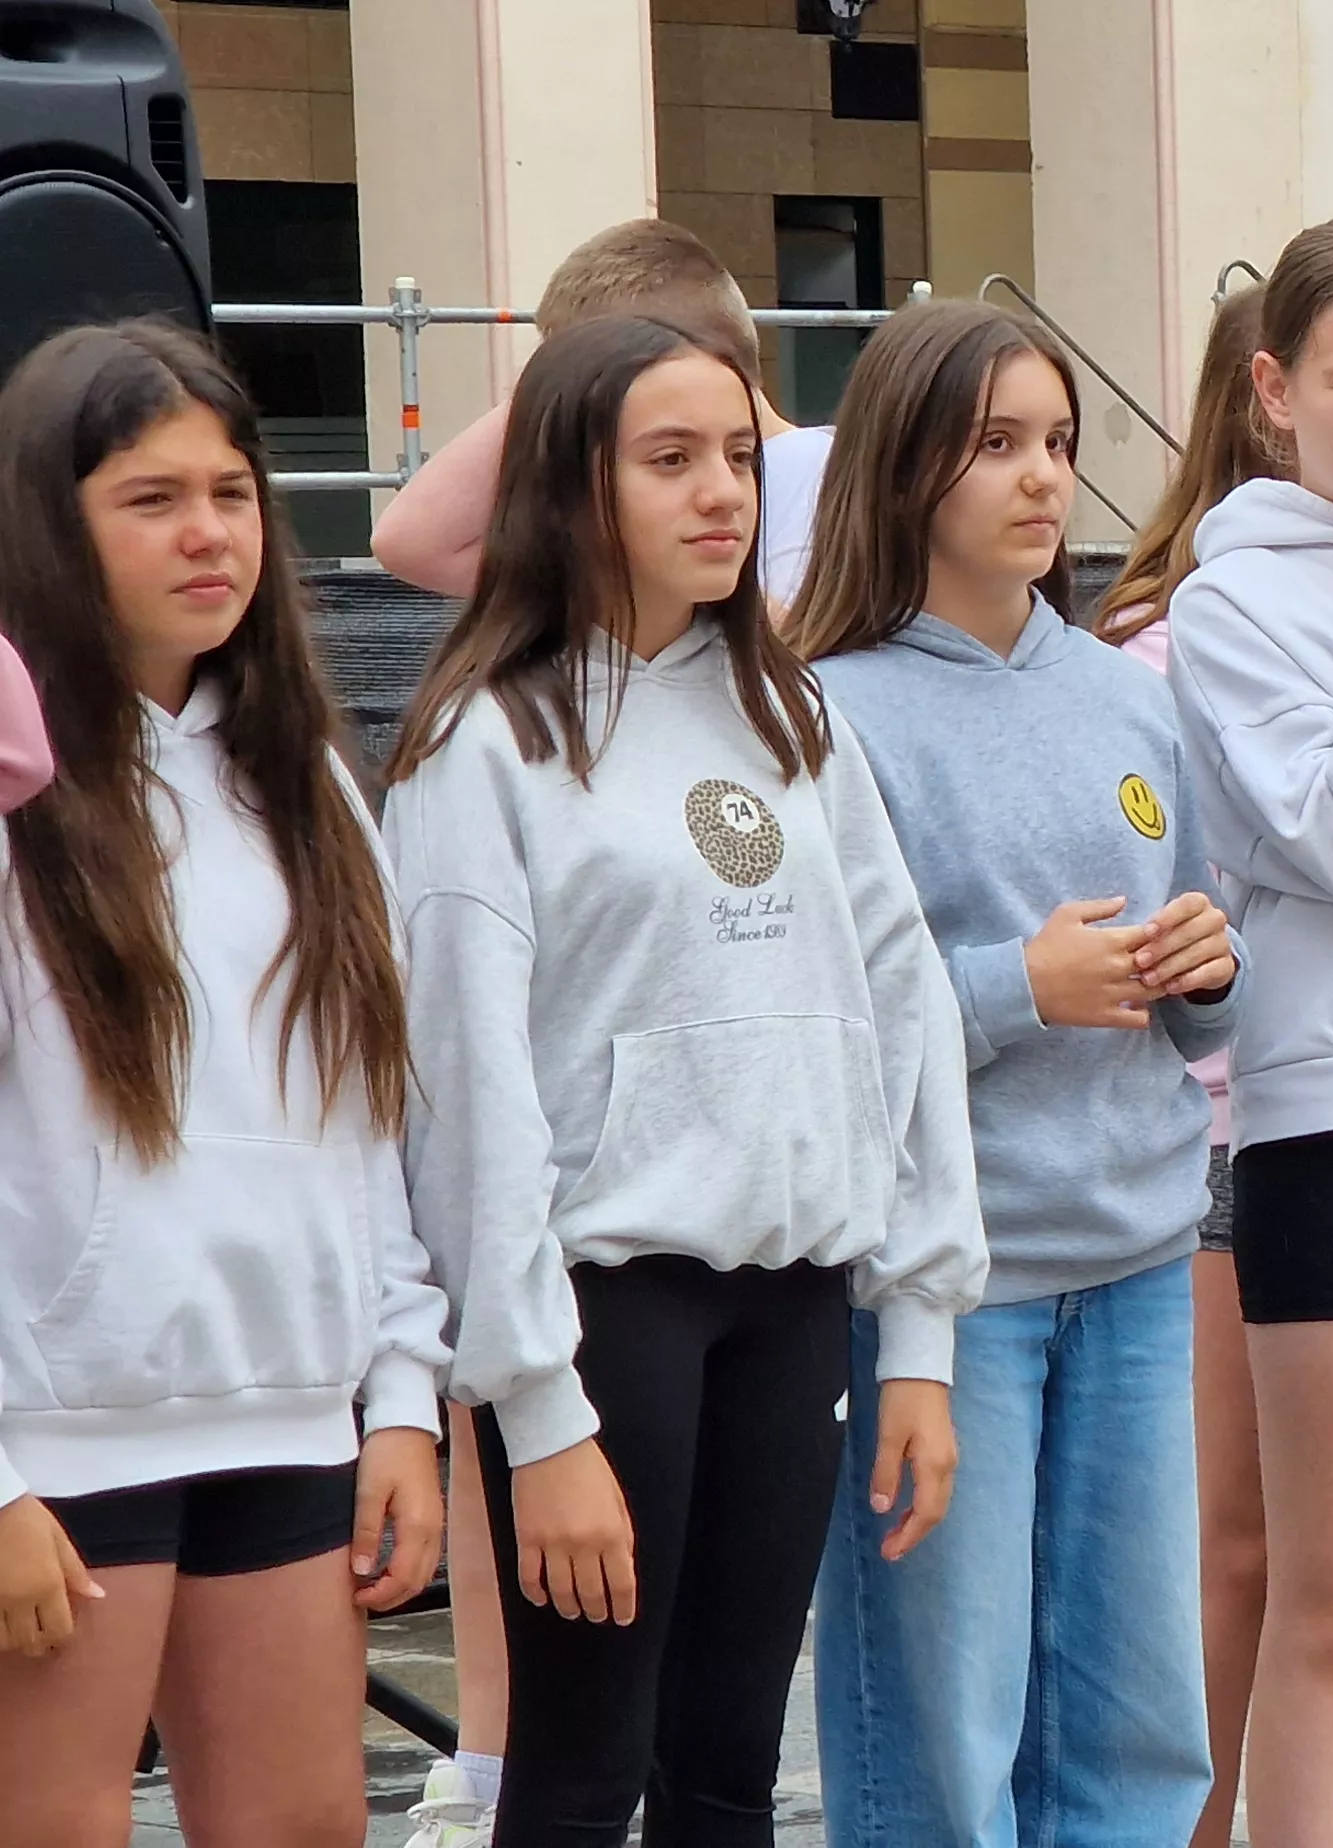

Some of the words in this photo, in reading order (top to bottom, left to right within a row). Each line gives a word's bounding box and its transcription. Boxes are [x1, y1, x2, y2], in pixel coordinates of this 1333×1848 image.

[727, 801, 754, 822] 74
[709, 896, 753, 924] Good
[717, 920, 761, 943] Since
